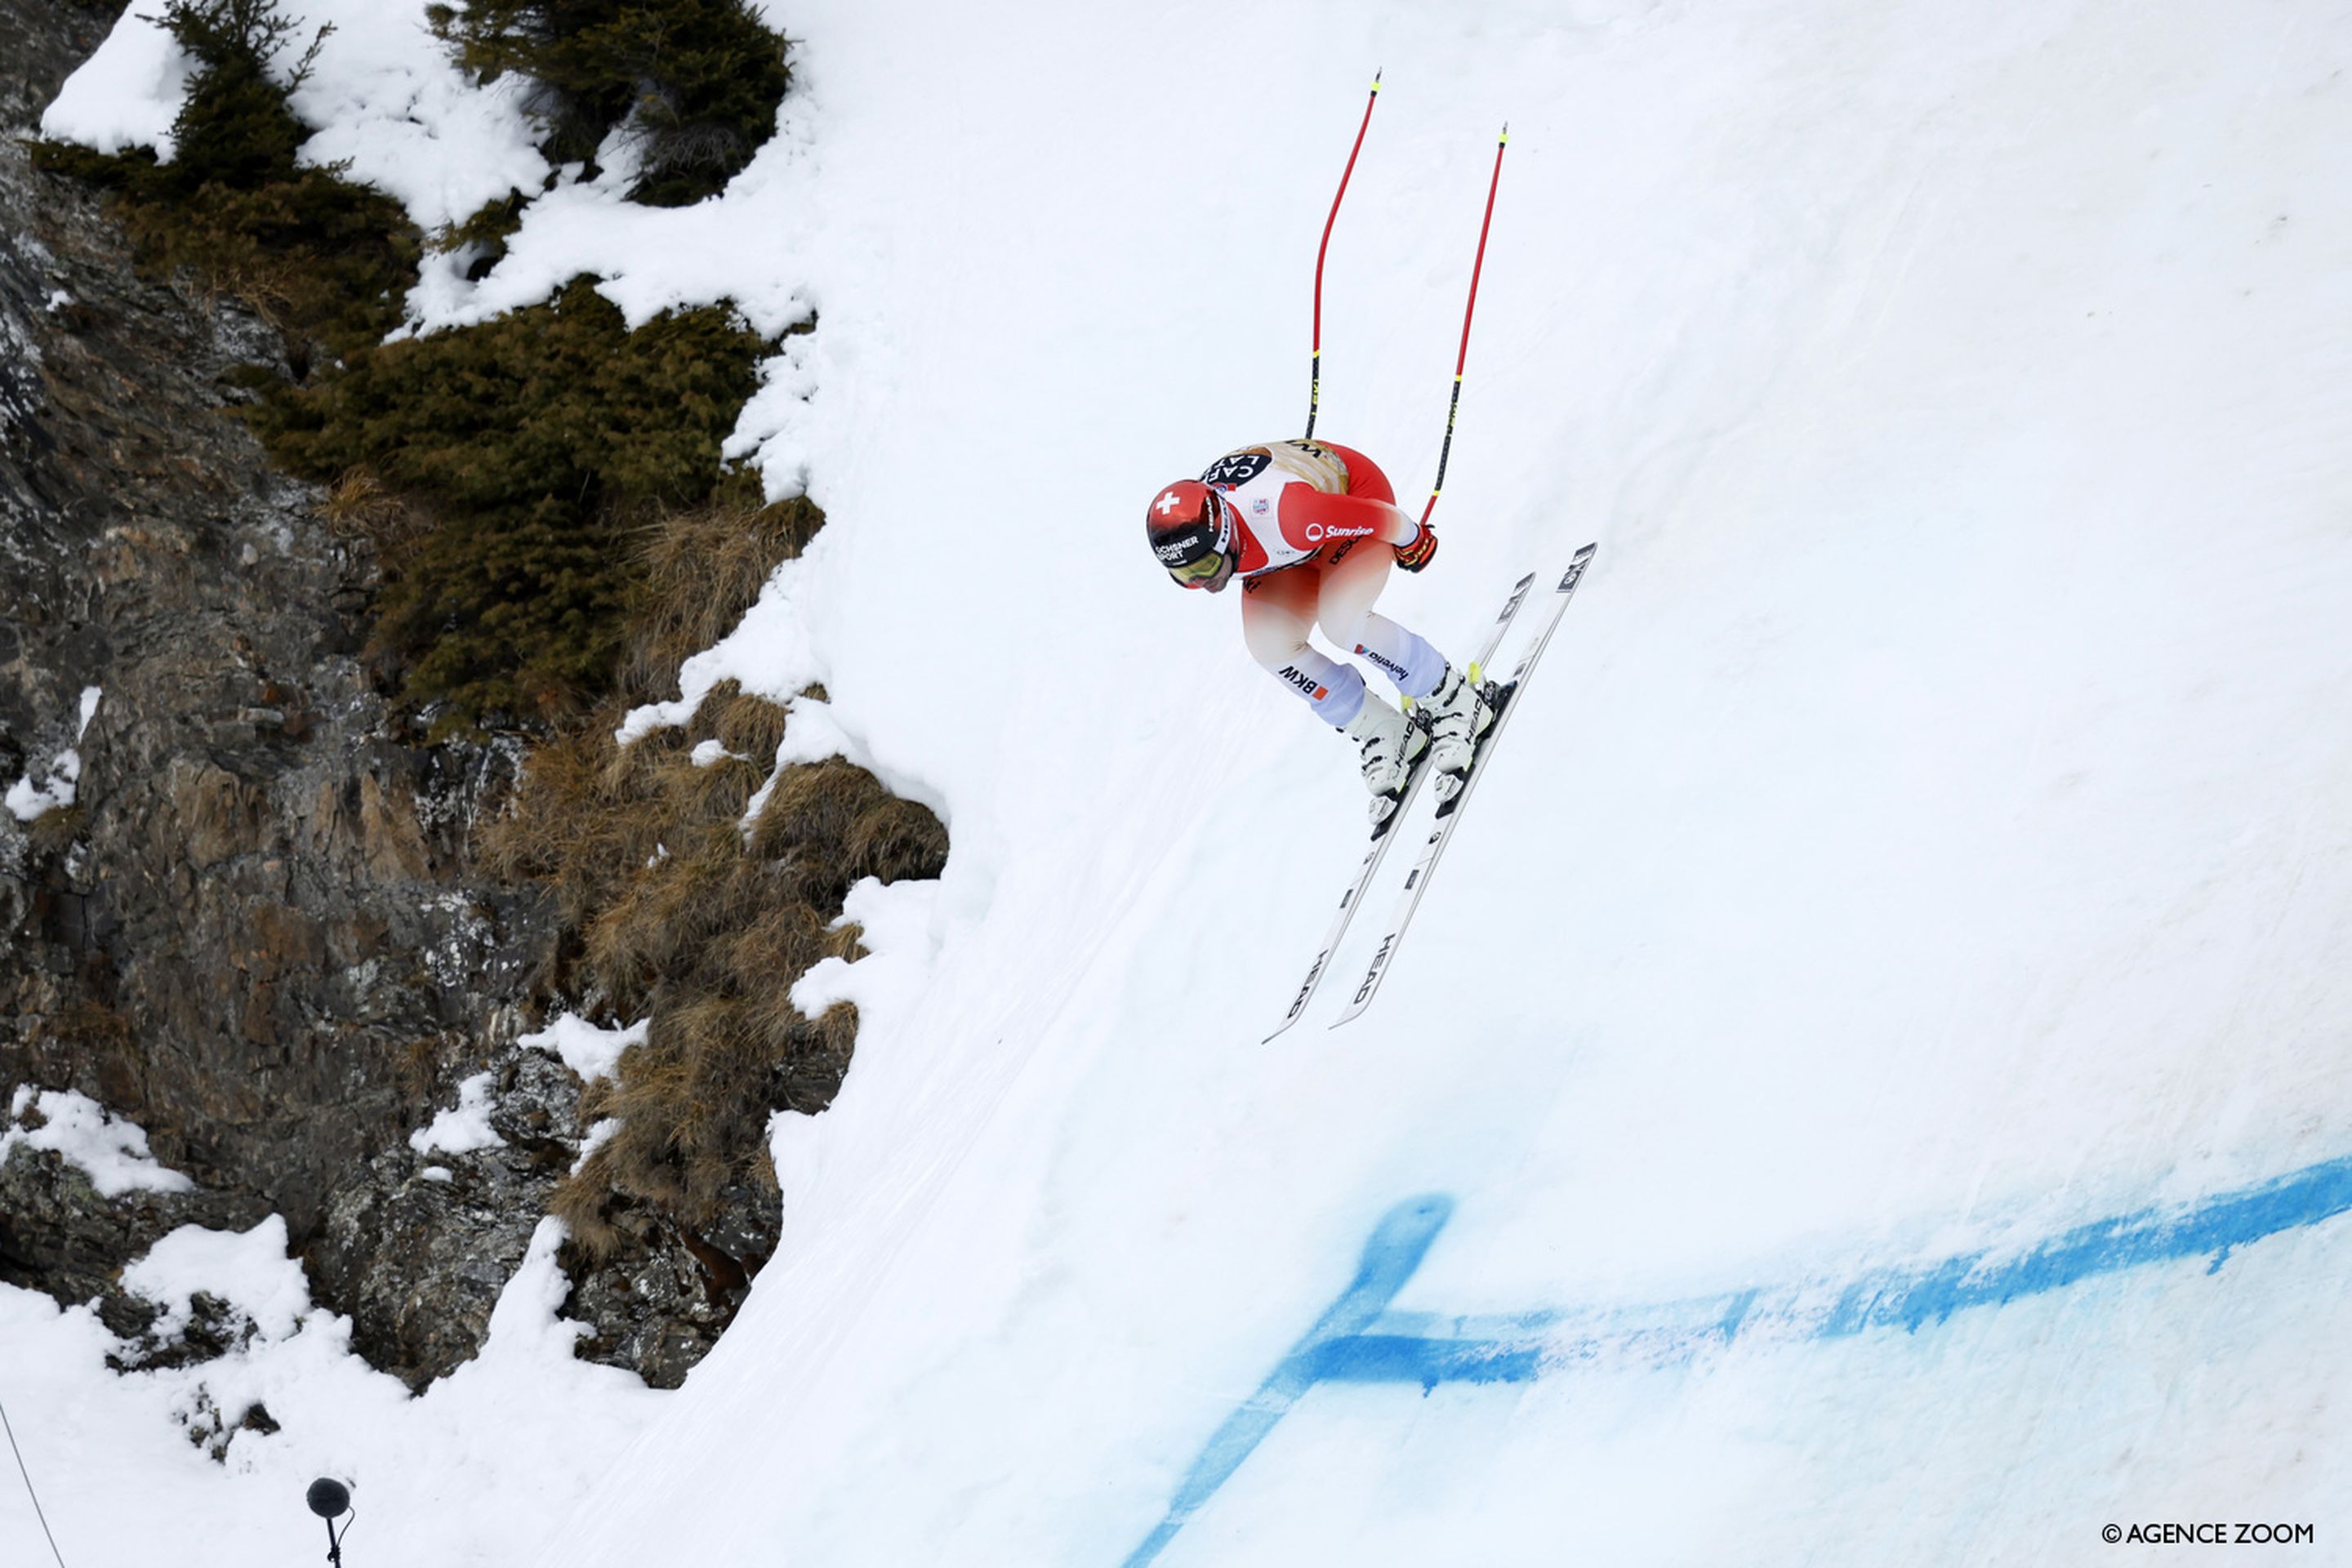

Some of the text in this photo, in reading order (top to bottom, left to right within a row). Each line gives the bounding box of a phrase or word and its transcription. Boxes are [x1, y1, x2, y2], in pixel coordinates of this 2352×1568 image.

[1325, 525, 1374, 538] Sunrise
[1278, 666, 1318, 695] BKW
[1368, 652, 1410, 681] helvetia
[1395, 721, 1415, 768] HEAD
[1465, 698, 1483, 745] HEAD
[1287, 949, 1330, 1019] HEAD
[1353, 933, 1396, 1004] HEAD
